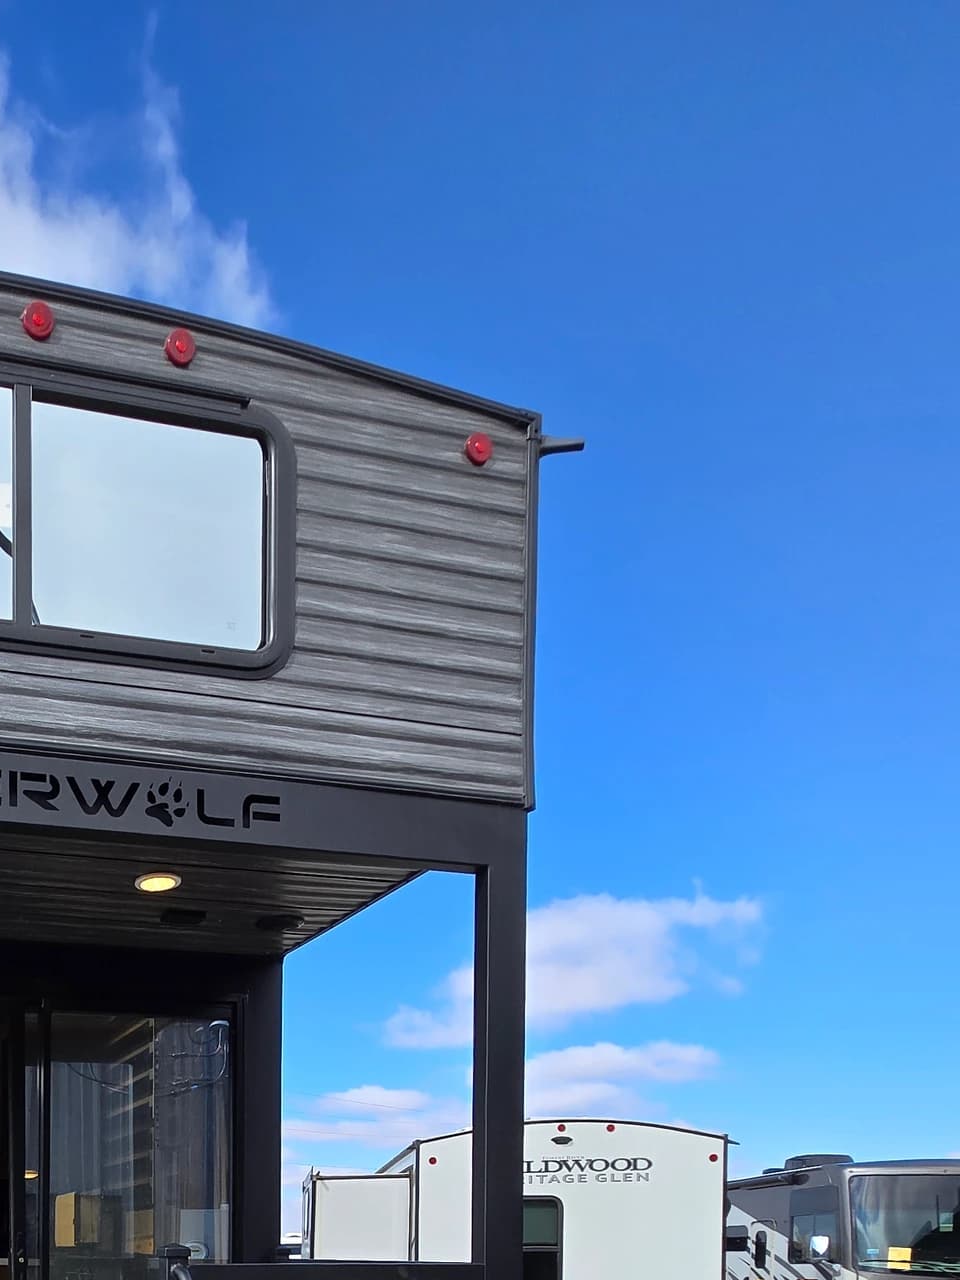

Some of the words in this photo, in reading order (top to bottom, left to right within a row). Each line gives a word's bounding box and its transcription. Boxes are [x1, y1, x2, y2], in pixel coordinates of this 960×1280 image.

[523, 1157, 652, 1173] LDWOOD
[528, 1174, 588, 1184] ITAGE
[595, 1173, 650, 1183] GLEN
